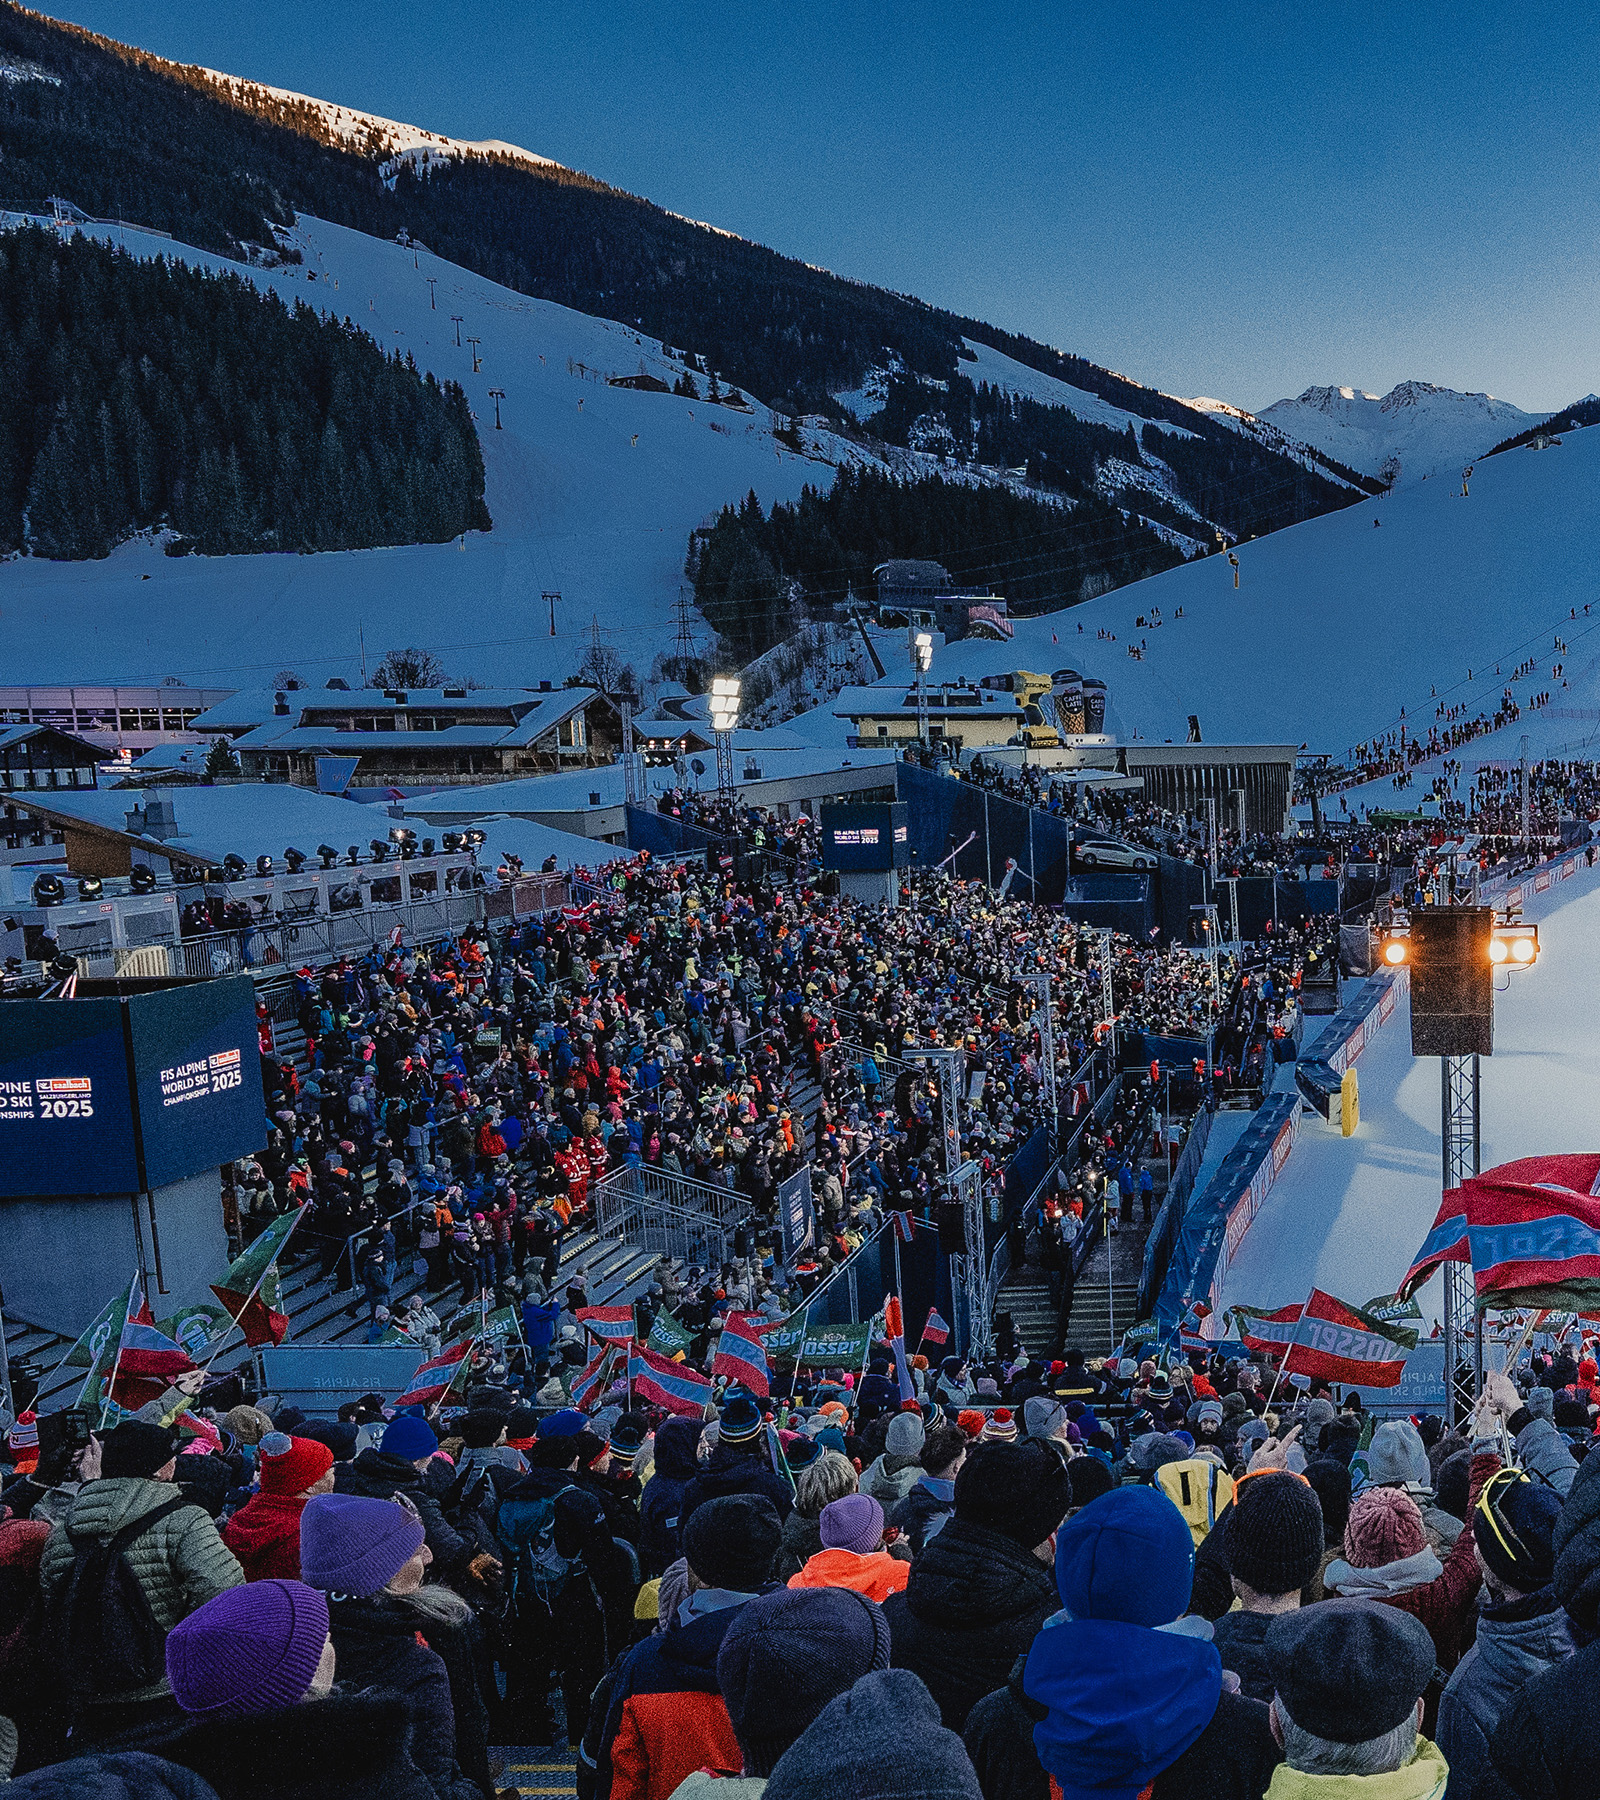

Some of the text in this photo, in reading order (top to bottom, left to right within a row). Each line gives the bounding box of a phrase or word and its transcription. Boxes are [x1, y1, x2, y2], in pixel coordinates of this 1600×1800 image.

[100, 904, 112, 912] ORF
[160, 1059, 207, 1082] FIS ALPINE
[53, 1079, 88, 1090] saalbach
[161, 1072, 209, 1096] WORLD SKI
[212, 1070, 242, 1093] 2025
[10, 1096, 33, 1108] SKI
[163, 1087, 210, 1107] CHAMPIONSHIPS
[40, 1100, 94, 1118] 2025
